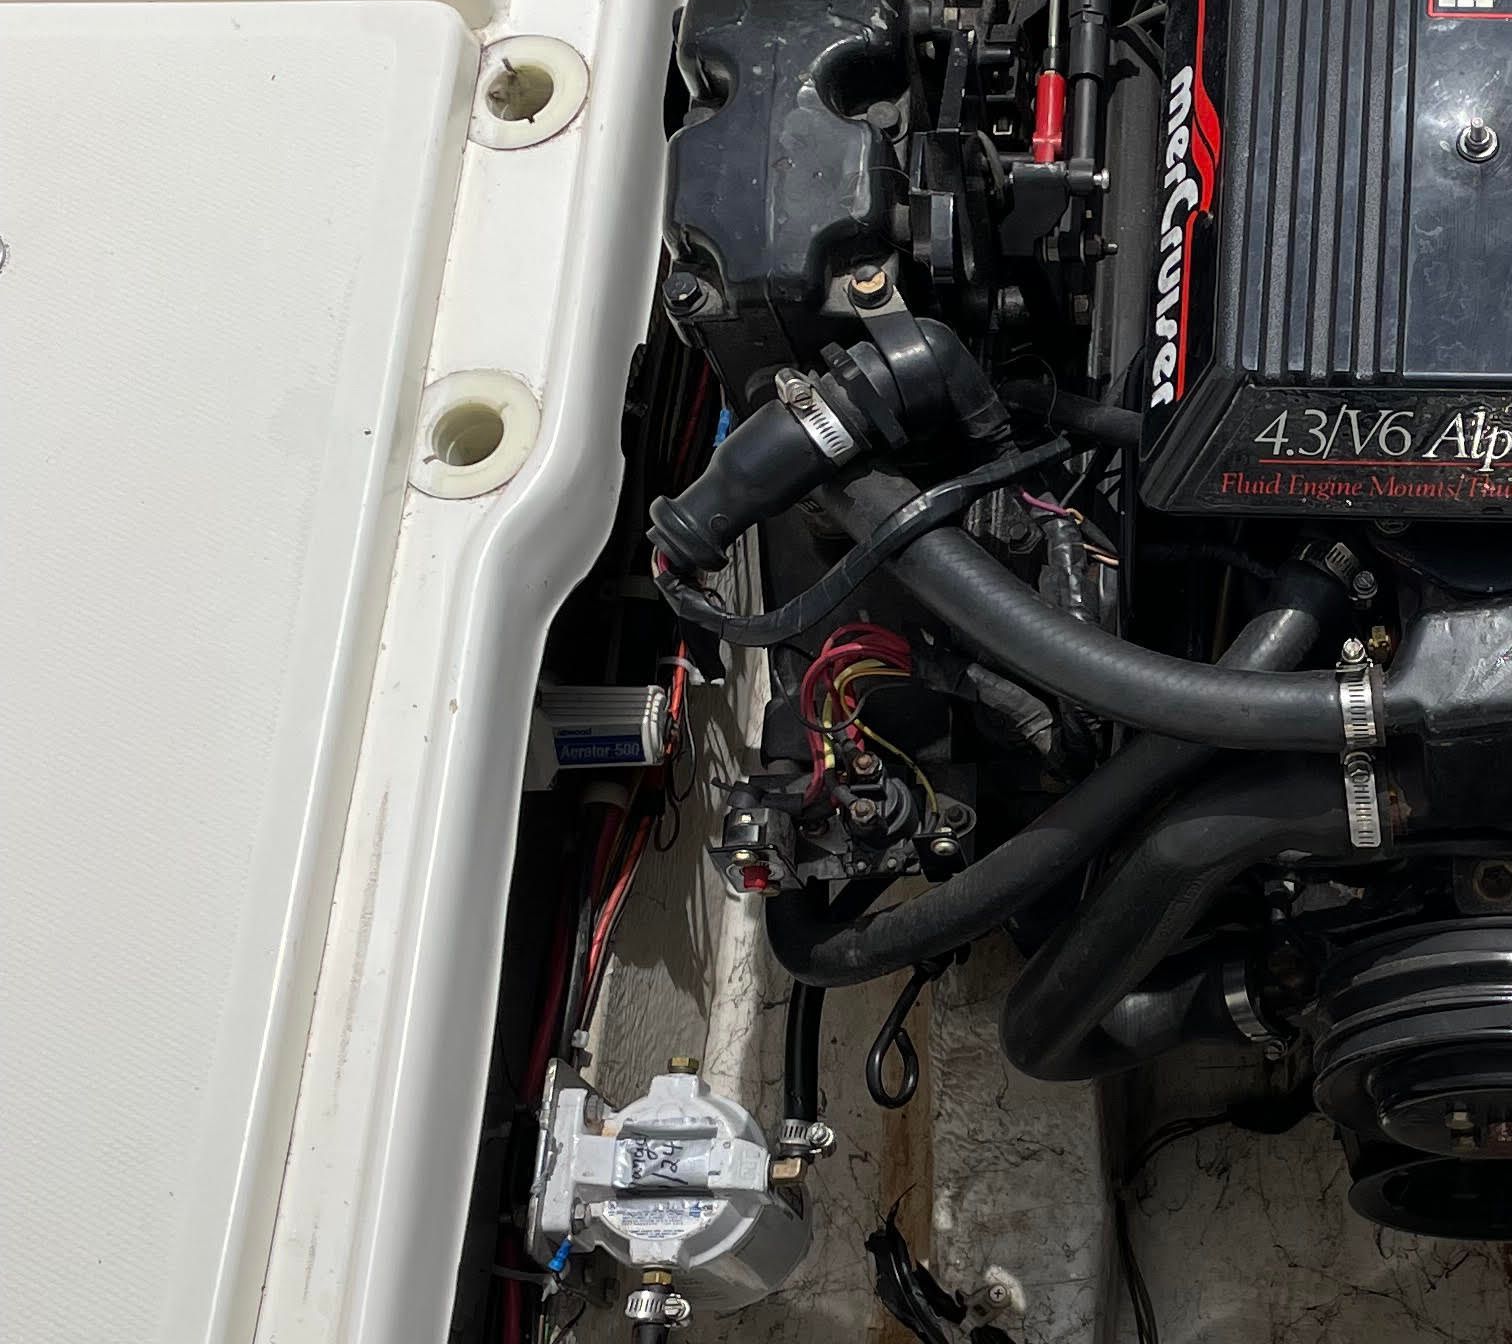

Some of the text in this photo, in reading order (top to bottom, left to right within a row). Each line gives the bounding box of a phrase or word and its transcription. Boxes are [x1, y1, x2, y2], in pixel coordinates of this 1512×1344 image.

[1254, 404, 1414, 459] 4.3/V6
[1220, 472, 1282, 494] Fluid
[1288, 474, 1363, 500] Engine
[614, 743, 641, 757] 500
